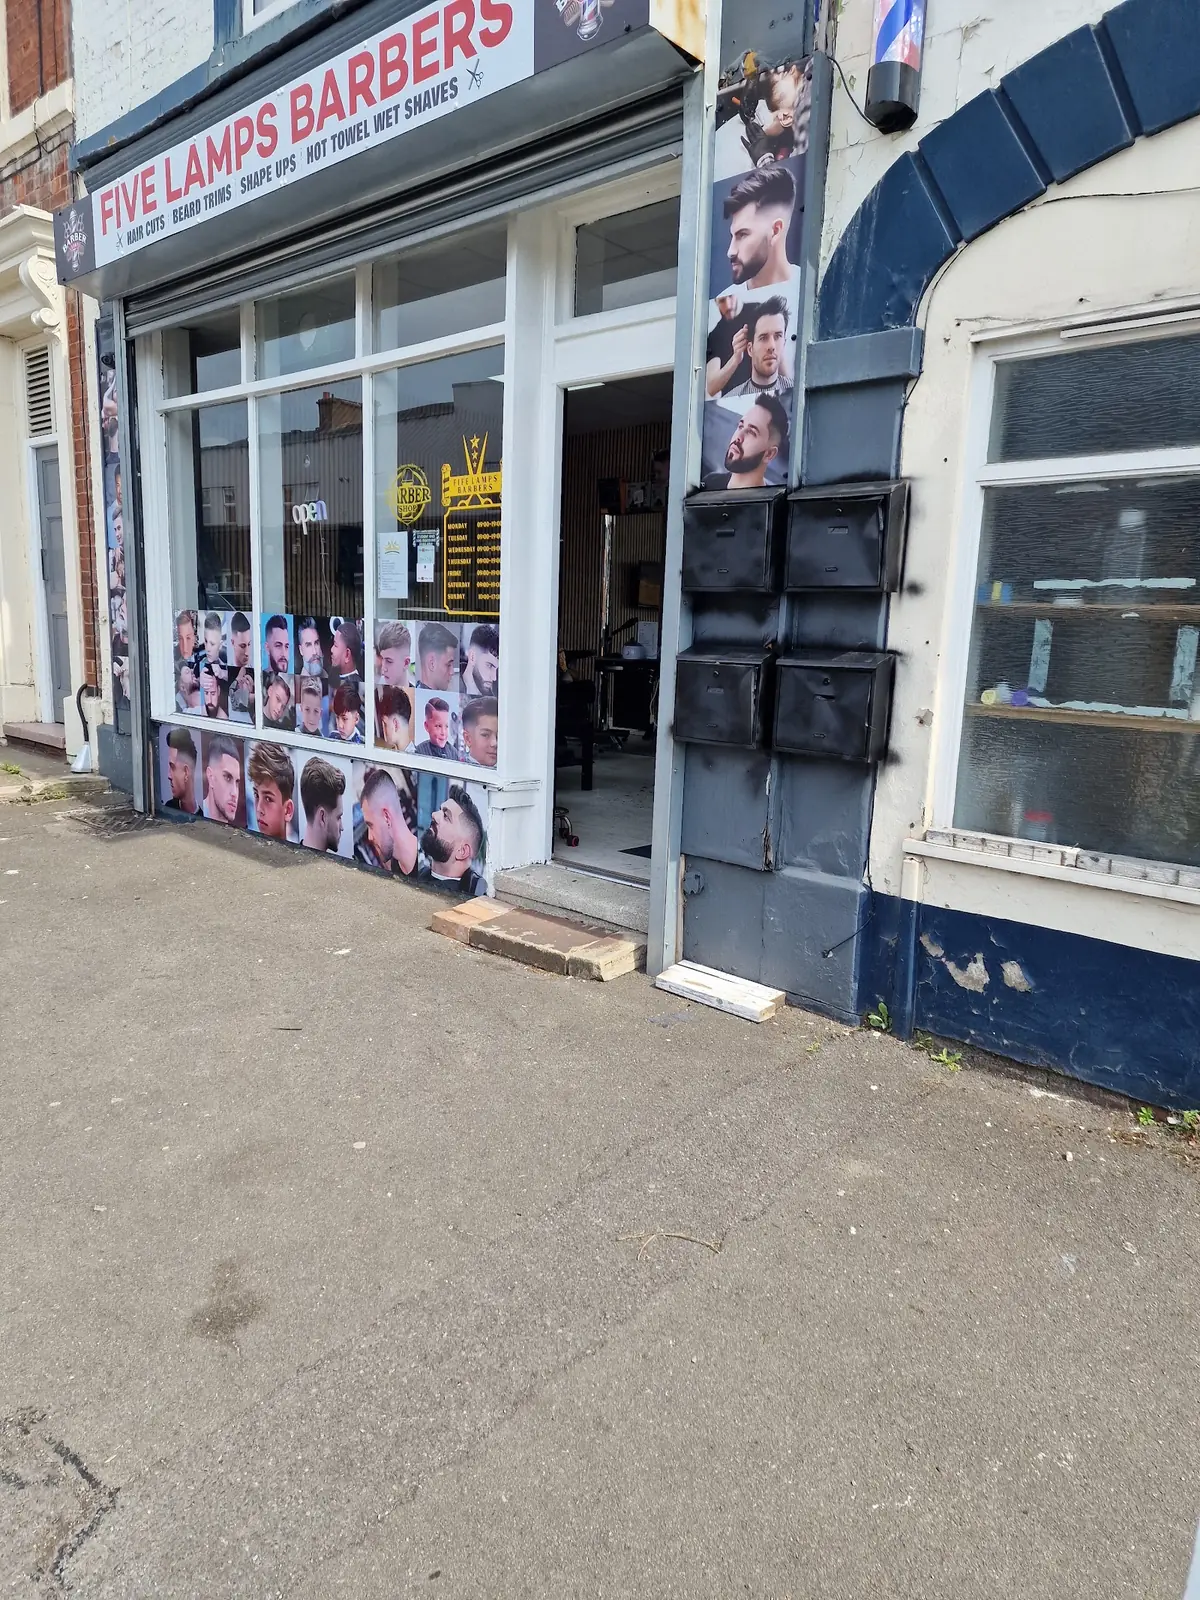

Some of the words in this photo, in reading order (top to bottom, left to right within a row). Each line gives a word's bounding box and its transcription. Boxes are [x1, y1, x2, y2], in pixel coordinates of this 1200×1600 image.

[100, 165, 157, 236] FIVE
[164, 103, 278, 203] LAMPS
[290, 0, 513, 144] BARBERS
[126, 227, 144, 246] HAIR
[145, 214, 165, 236] CUTS
[172, 198, 201, 224] BEARD
[203, 184, 232, 211] TRIMS
[240, 164, 272, 195] SHAPE
[275, 153, 297, 179] UPS
[306, 138, 327, 164] HOT
[330, 119, 370, 153] TOWEL
[373, 103, 400, 133] WET
[404, 76, 459, 120] SHAVES
[62, 232, 87, 253] BARBER
[471, 474, 498, 484] LAMPS
[457, 483, 493, 494] BARBERS
[398, 504, 418, 513] SHOP
[292, 500, 328, 535] open
[447, 522, 468, 530] MONDAY
[447, 534, 468, 542] TUESDAY
